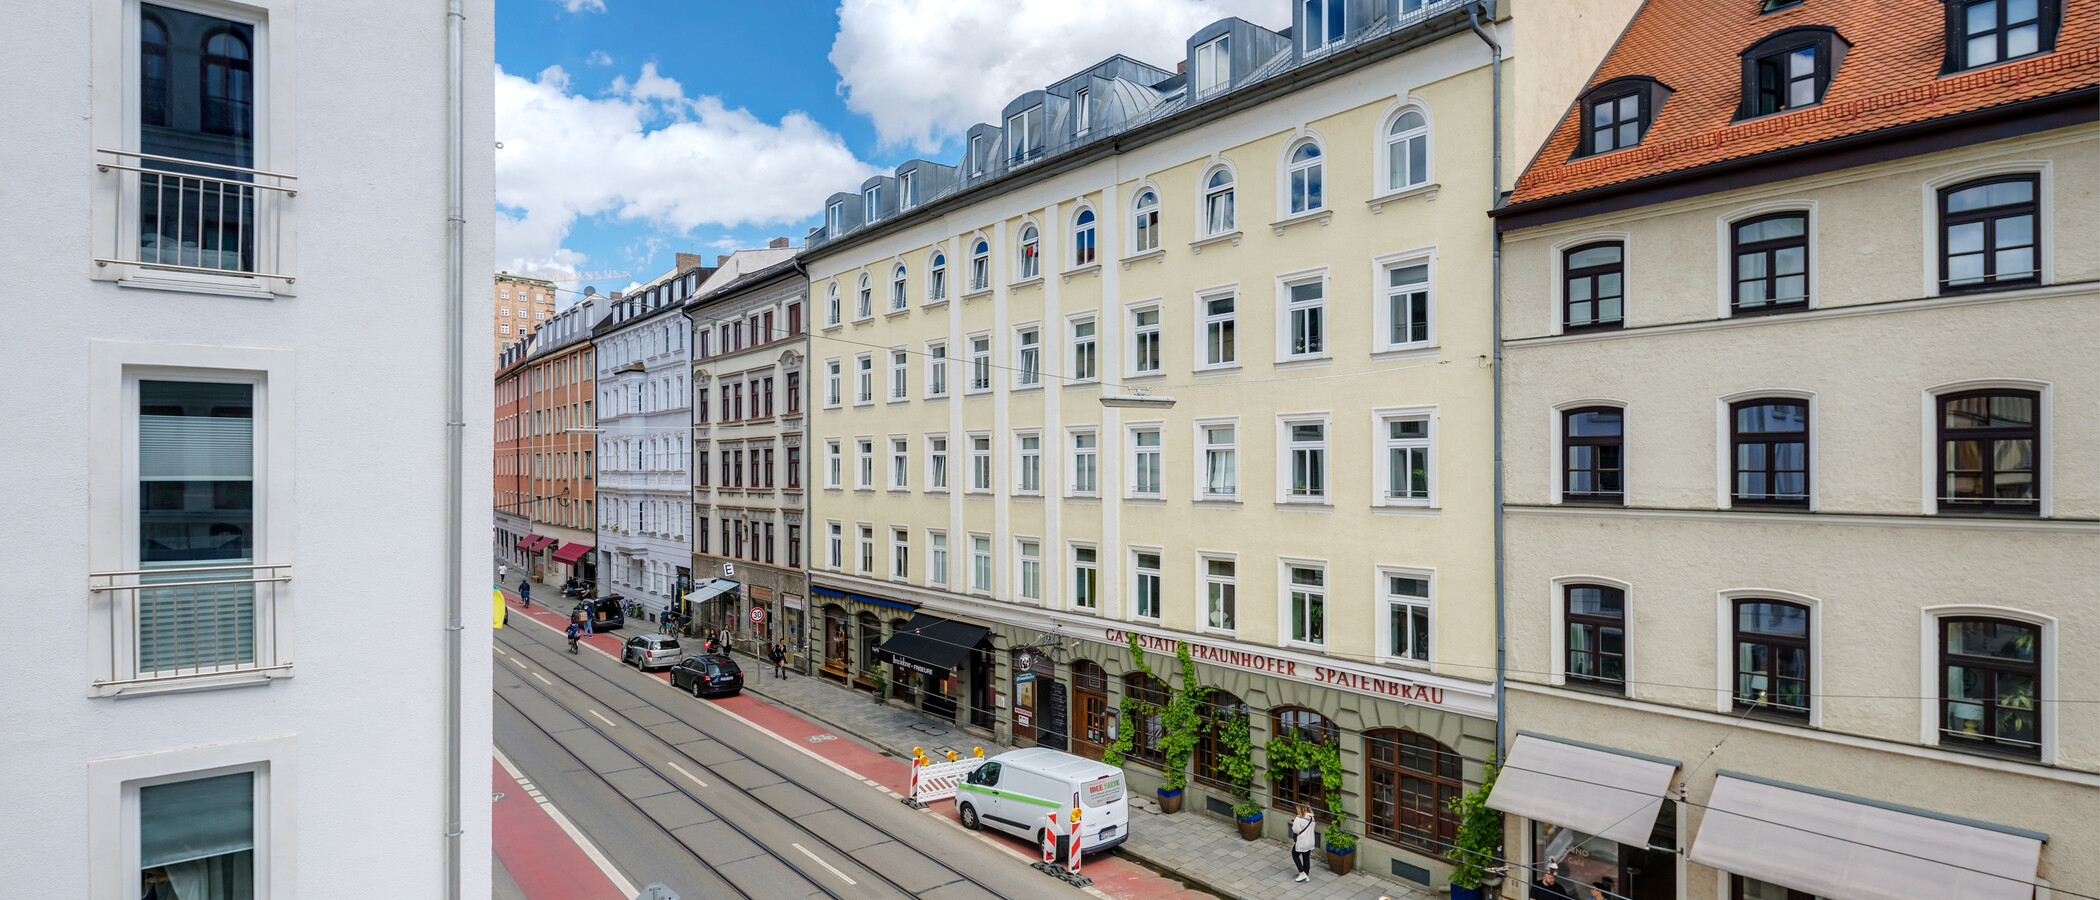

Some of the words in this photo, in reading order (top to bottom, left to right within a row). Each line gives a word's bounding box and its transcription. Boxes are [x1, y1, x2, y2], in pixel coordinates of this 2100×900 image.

[725, 564, 733, 575] E
[752, 611, 762, 619] 30
[1105, 628, 1185, 654] GASTSTÄTT
[1192, 644, 1296, 676] FRAUNHOFER
[1314, 666, 1443, 704] SPATENBRÄU
